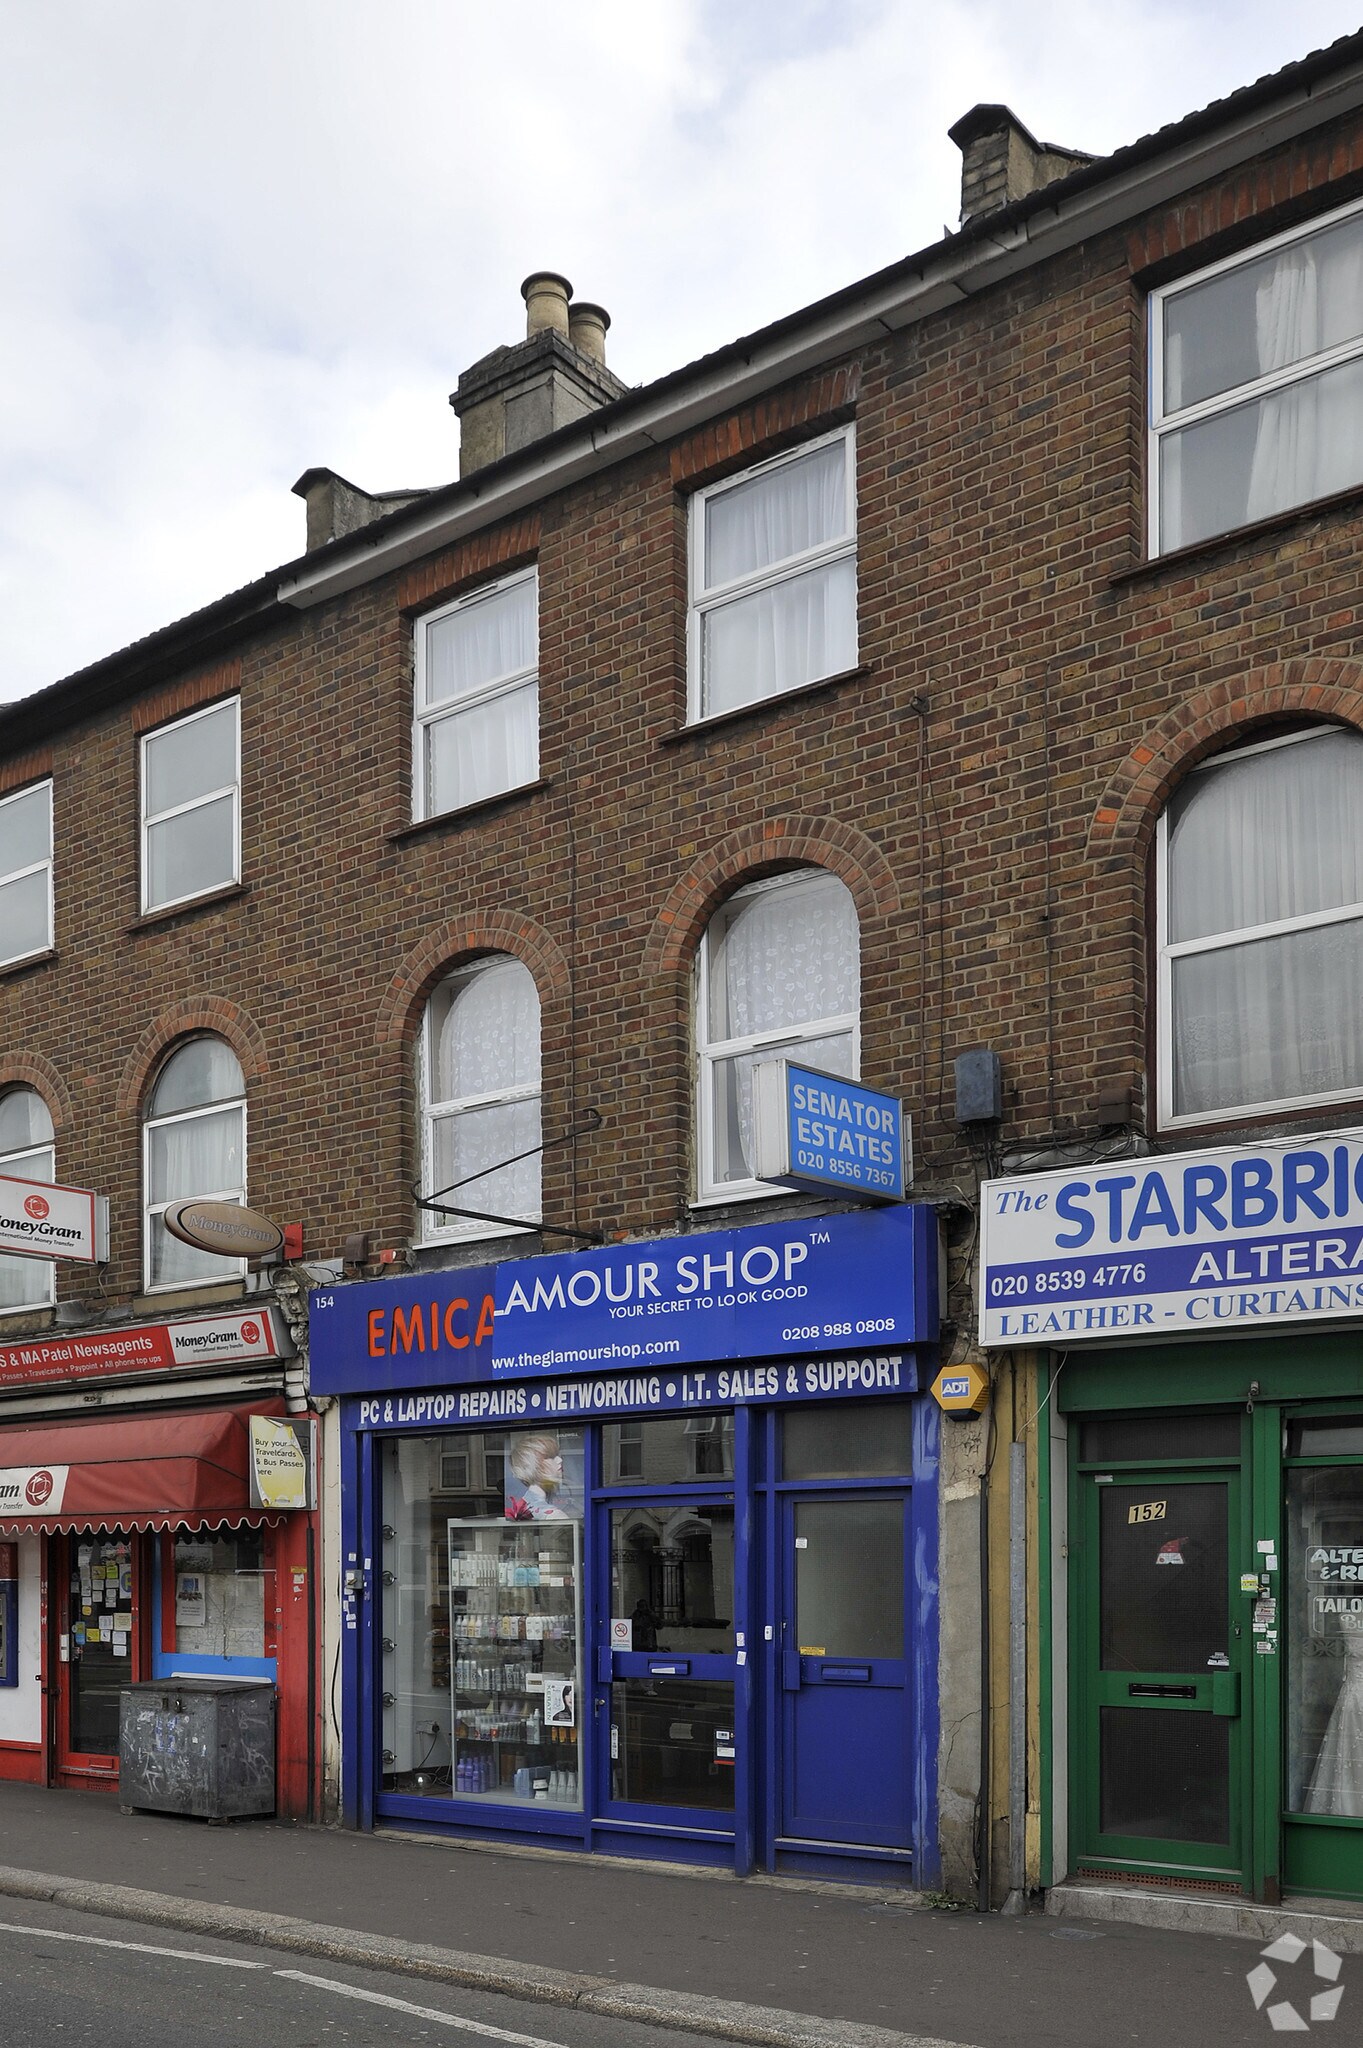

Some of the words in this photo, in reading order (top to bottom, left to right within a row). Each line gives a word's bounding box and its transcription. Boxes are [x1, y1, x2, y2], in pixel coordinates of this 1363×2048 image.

[793, 1084, 895, 1136] SENATOR
[797, 1117, 894, 1165] ESTATES
[798, 1150, 825, 1170] 020
[829, 1158, 861, 1179] 8556
[865, 1166, 895, 1187] 7367
[996, 1188, 1048, 1215] The
[1054, 1145, 1363, 1249] STARBRI
[0, 1216, 82, 1240] oneyGram
[34, 1236, 53, 1245] Money
[53, 1239, 75, 1248] Transfer
[188, 1213, 275, 1243] MoneyGram
[494, 1261, 662, 1317] AMOUR
[676, 1241, 808, 1295] SHOP
[991, 1276, 1028, 1298] 020
[1035, 1269, 1086, 1293] 8539
[1092, 1263, 1146, 1287] 4776
[315, 1296, 335, 1309] 154
[608, 1304, 644, 1319] YOUR
[647, 1298, 692, 1315] SECRET
[694, 1295, 714, 1309] TO
[717, 1290, 758, 1308] LOOK
[761, 1285, 808, 1302] GOOD
[782, 1325, 820, 1341] 0208
[823, 1321, 852, 1337] 988
[855, 1317, 896, 1333] 0808
[999, 1302, 1155, 1337] LEATHER
[10, 1353, 19, 1366] &
[20, 1349, 42, 1365] MA
[41, 1345, 73, 1362] Patel
[74, 1336, 153, 1359] Newsagents
[175, 1331, 238, 1348] MoneyGram
[2, 1373, 24, 1381] Passes
[28, 1367, 64, 1377] Travelcards
[69, 1362, 98, 1374] Paypoint
[104, 1360, 114, 1368] All
[115, 1358, 135, 1368] phone
[136, 1357, 148, 1367] top
[149, 1355, 162, 1366] ups
[360, 1399, 380, 1424] PC
[383, 1397, 393, 1422] &
[397, 1393, 455, 1422] LAPTOP
[459, 1388, 526, 1418] REPAIRS
[546, 1375, 660, 1411] NETWORKING
[682, 1372, 712, 1401] I.T.
[717, 1366, 779, 1399] SALES
[785, 1364, 799, 1393] &
[805, 1355, 903, 1392] SUPPORT
[942, 1381, 969, 1394] ADT
[255, 1438, 269, 1447] Buy
[255, 1448, 297, 1457] Travelcards
[279, 1460, 304, 1468] Passes
[1133, 1503, 1165, 1521] 152
